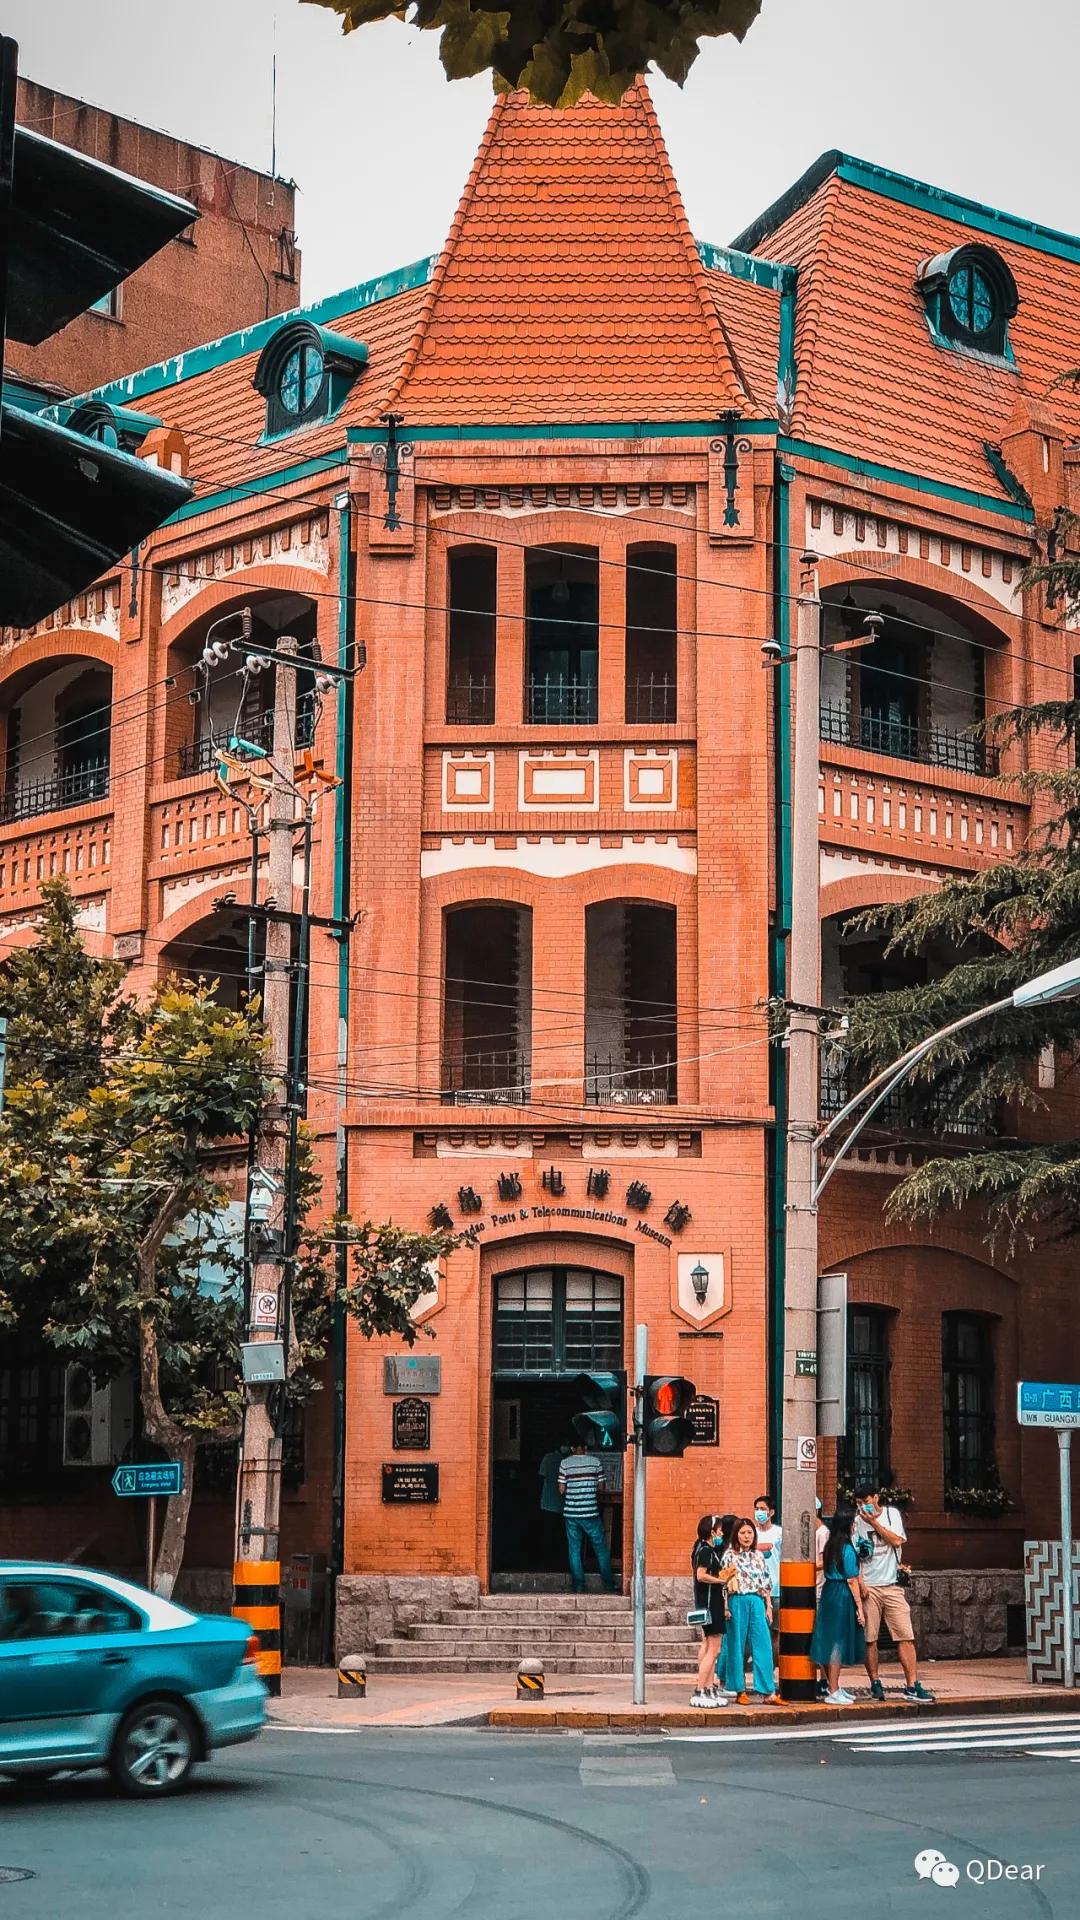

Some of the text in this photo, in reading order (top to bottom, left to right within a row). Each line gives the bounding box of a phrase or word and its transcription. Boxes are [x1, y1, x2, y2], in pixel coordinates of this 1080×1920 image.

[491, 1213, 517, 1228] Posts
[520, 1208, 529, 1221] &
[531, 1206, 628, 1227] Telecommunications
[635, 1220, 673, 1248] Museum
[1042, 1389, 1080, 1409] 广西
[1044, 1414, 1078, 1424] GUANGXI
